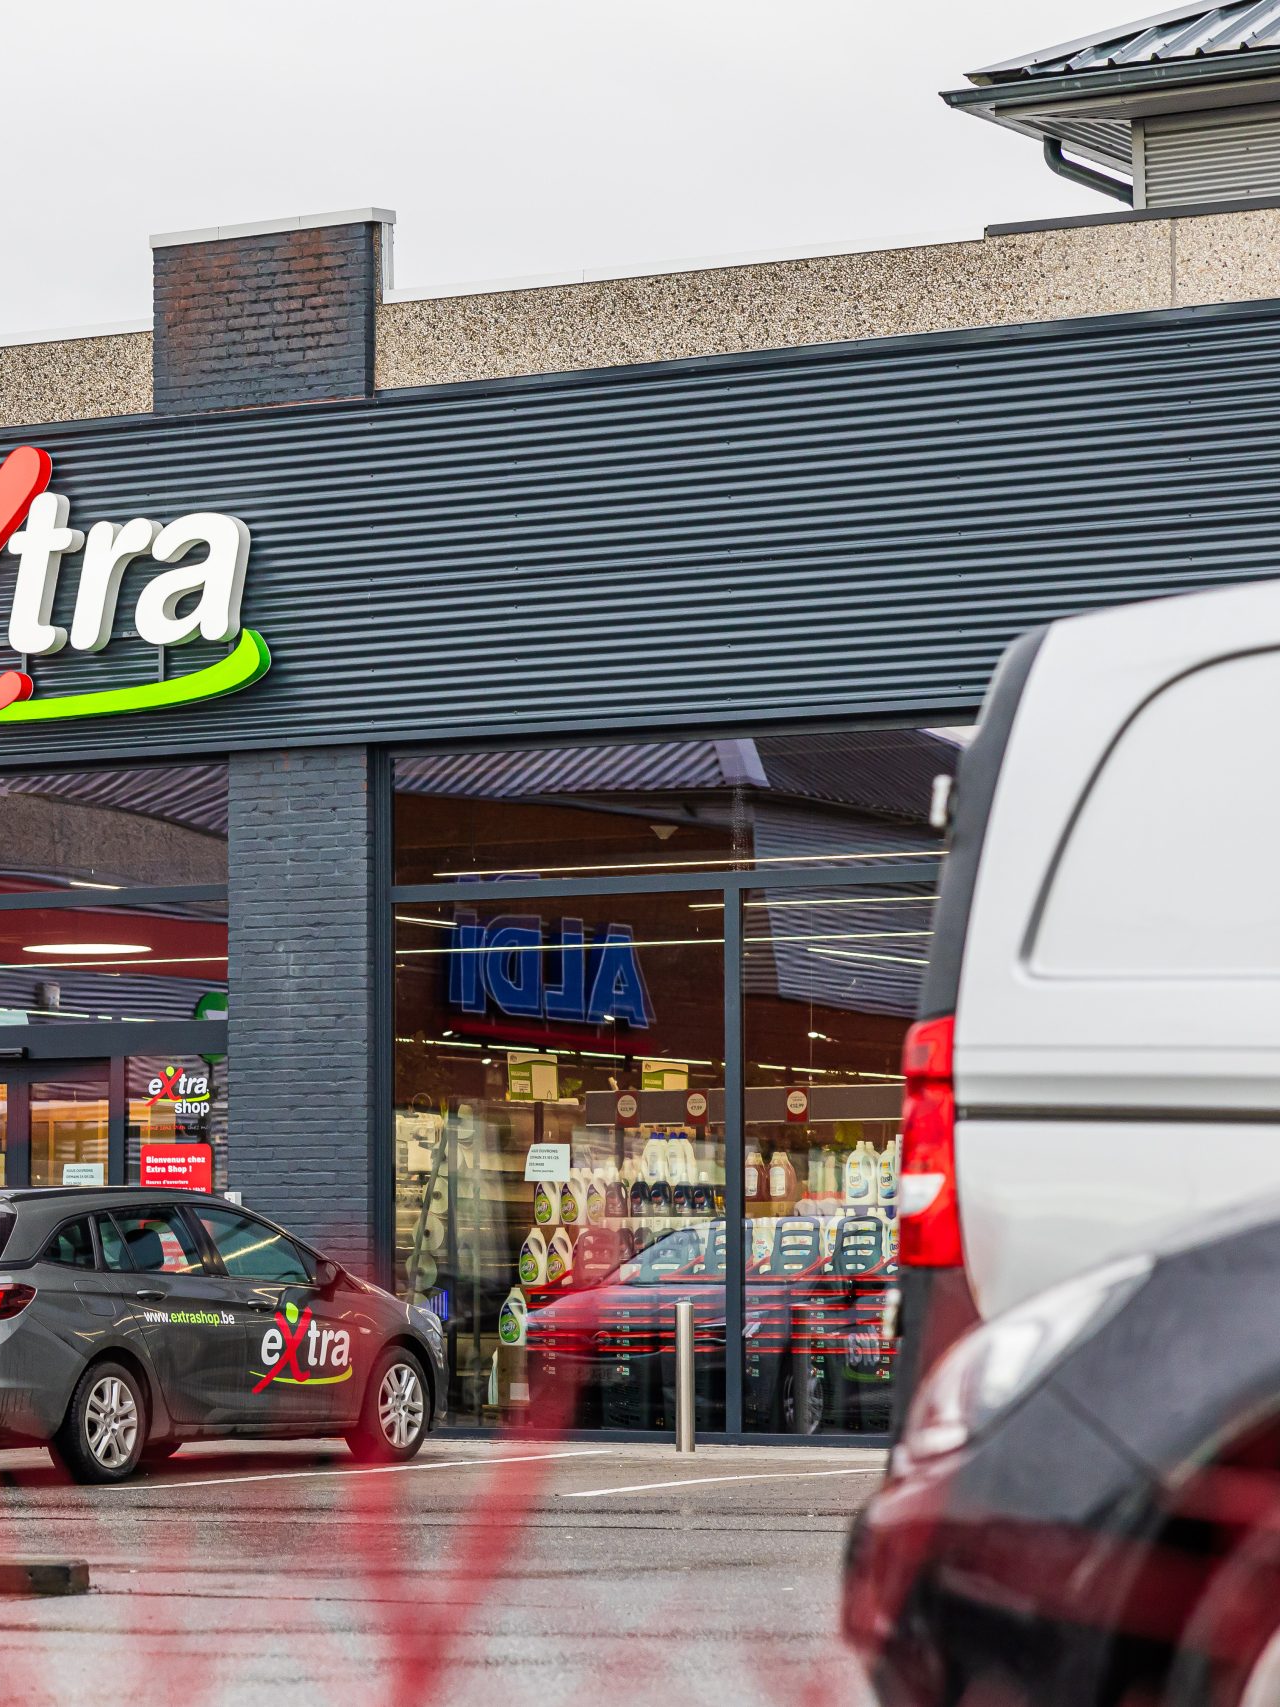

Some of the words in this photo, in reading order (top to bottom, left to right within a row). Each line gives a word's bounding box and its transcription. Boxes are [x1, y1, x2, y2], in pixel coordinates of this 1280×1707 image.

[175, 1100, 209, 1116] shop
[146, 1156, 186, 1164] Bienvenue
[168, 1165, 187, 1174] Shop
[144, 1310, 235, 1327] www.extrashop.be
